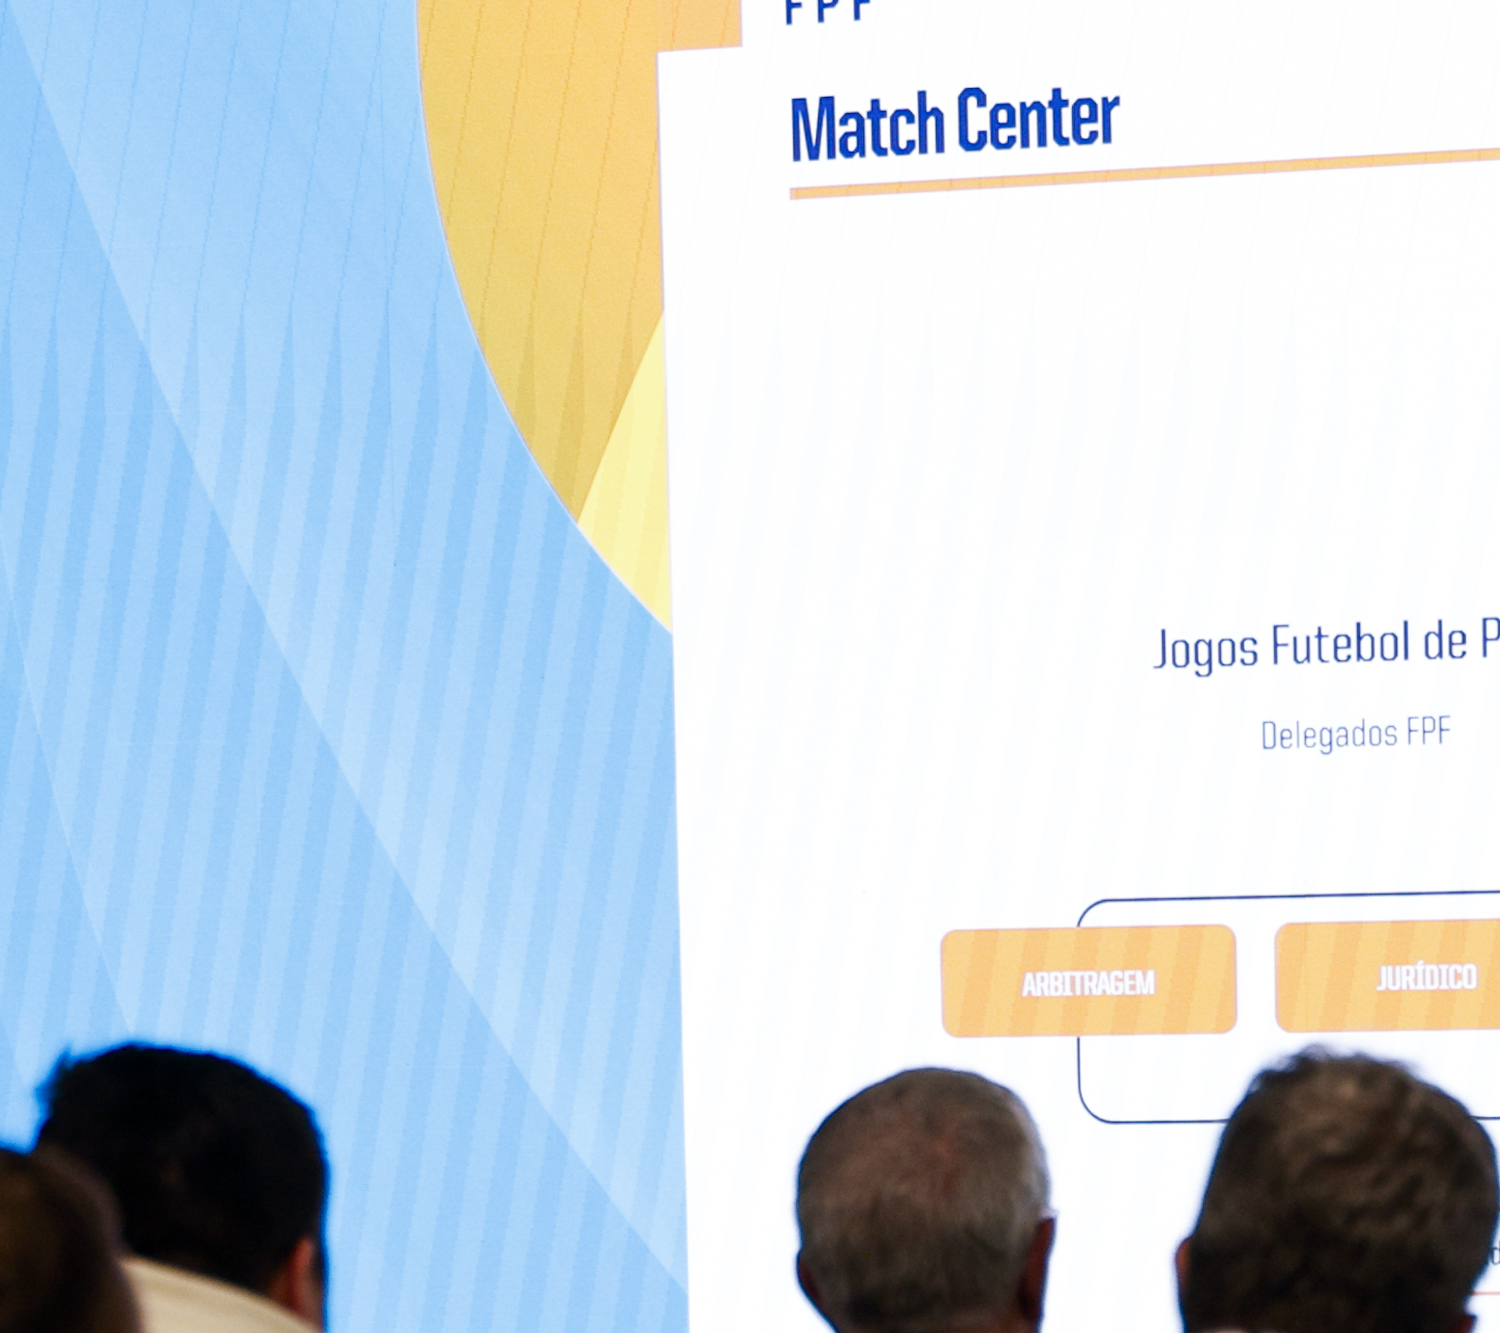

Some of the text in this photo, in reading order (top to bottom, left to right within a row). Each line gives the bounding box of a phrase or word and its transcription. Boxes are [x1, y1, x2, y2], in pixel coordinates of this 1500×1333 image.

[791, 87, 1120, 162] Match Center
[1153, 629, 1259, 678] Jogos
[1272, 619, 1410, 666] Futebol
[1423, 618, 1467, 661] de
[1262, 715, 1451, 756] Delegados FPF
[1021, 969, 1156, 998] ARBITRAGEM
[1376, 960, 1478, 992] JURÍDICO
